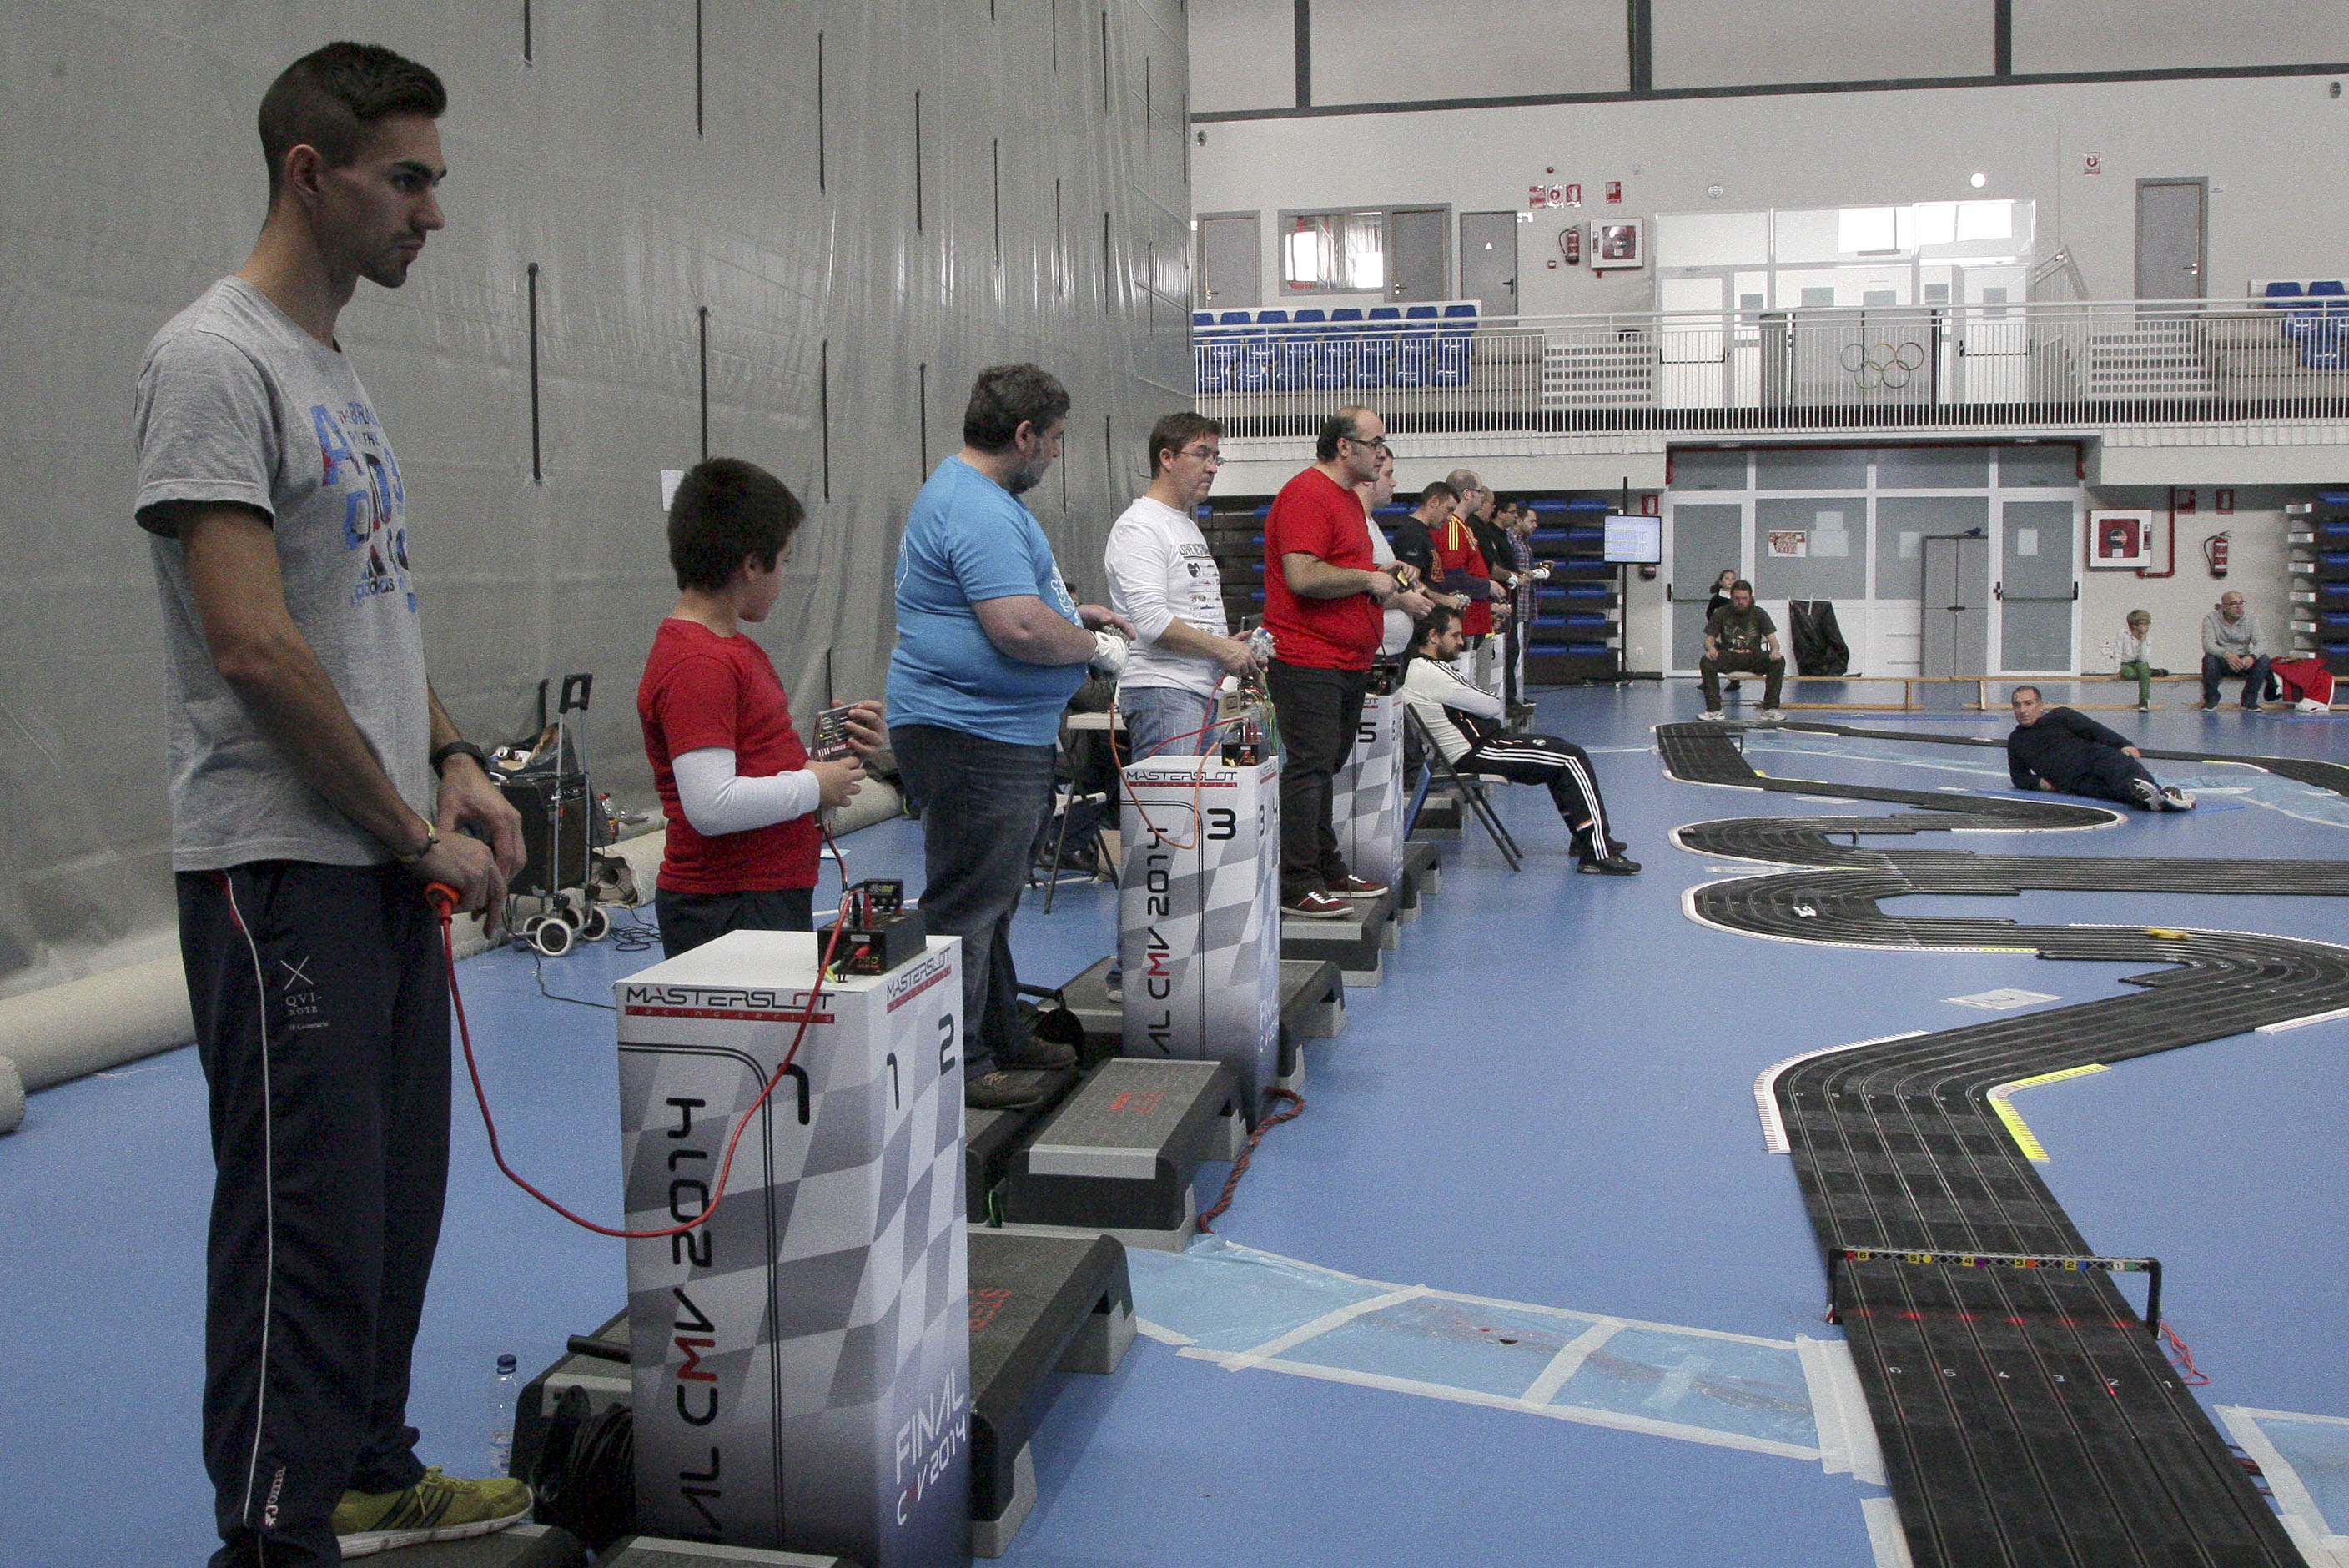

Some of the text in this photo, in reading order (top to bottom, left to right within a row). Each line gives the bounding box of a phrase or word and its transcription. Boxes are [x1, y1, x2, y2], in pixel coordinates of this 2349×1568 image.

[1358, 722, 1376, 742] 5
[1126, 771, 1238, 781] MASTERSLOT
[1207, 808, 1236, 840] 3
[1147, 827, 1169, 916] 2014
[626, 986, 835, 1010] MASTERSLOT
[887, 947, 951, 1000] MASTERSLOT
[1147, 927, 1171, 1000] CMV
[777, 1063, 810, 1126] 1
[887, 1013, 956, 1110] 1 2
[666, 1097, 713, 1268] 2014
[674, 1287, 717, 1426] CMV
[896, 1366, 965, 1485] FINAL
[930, 1414, 966, 1485] 2014
